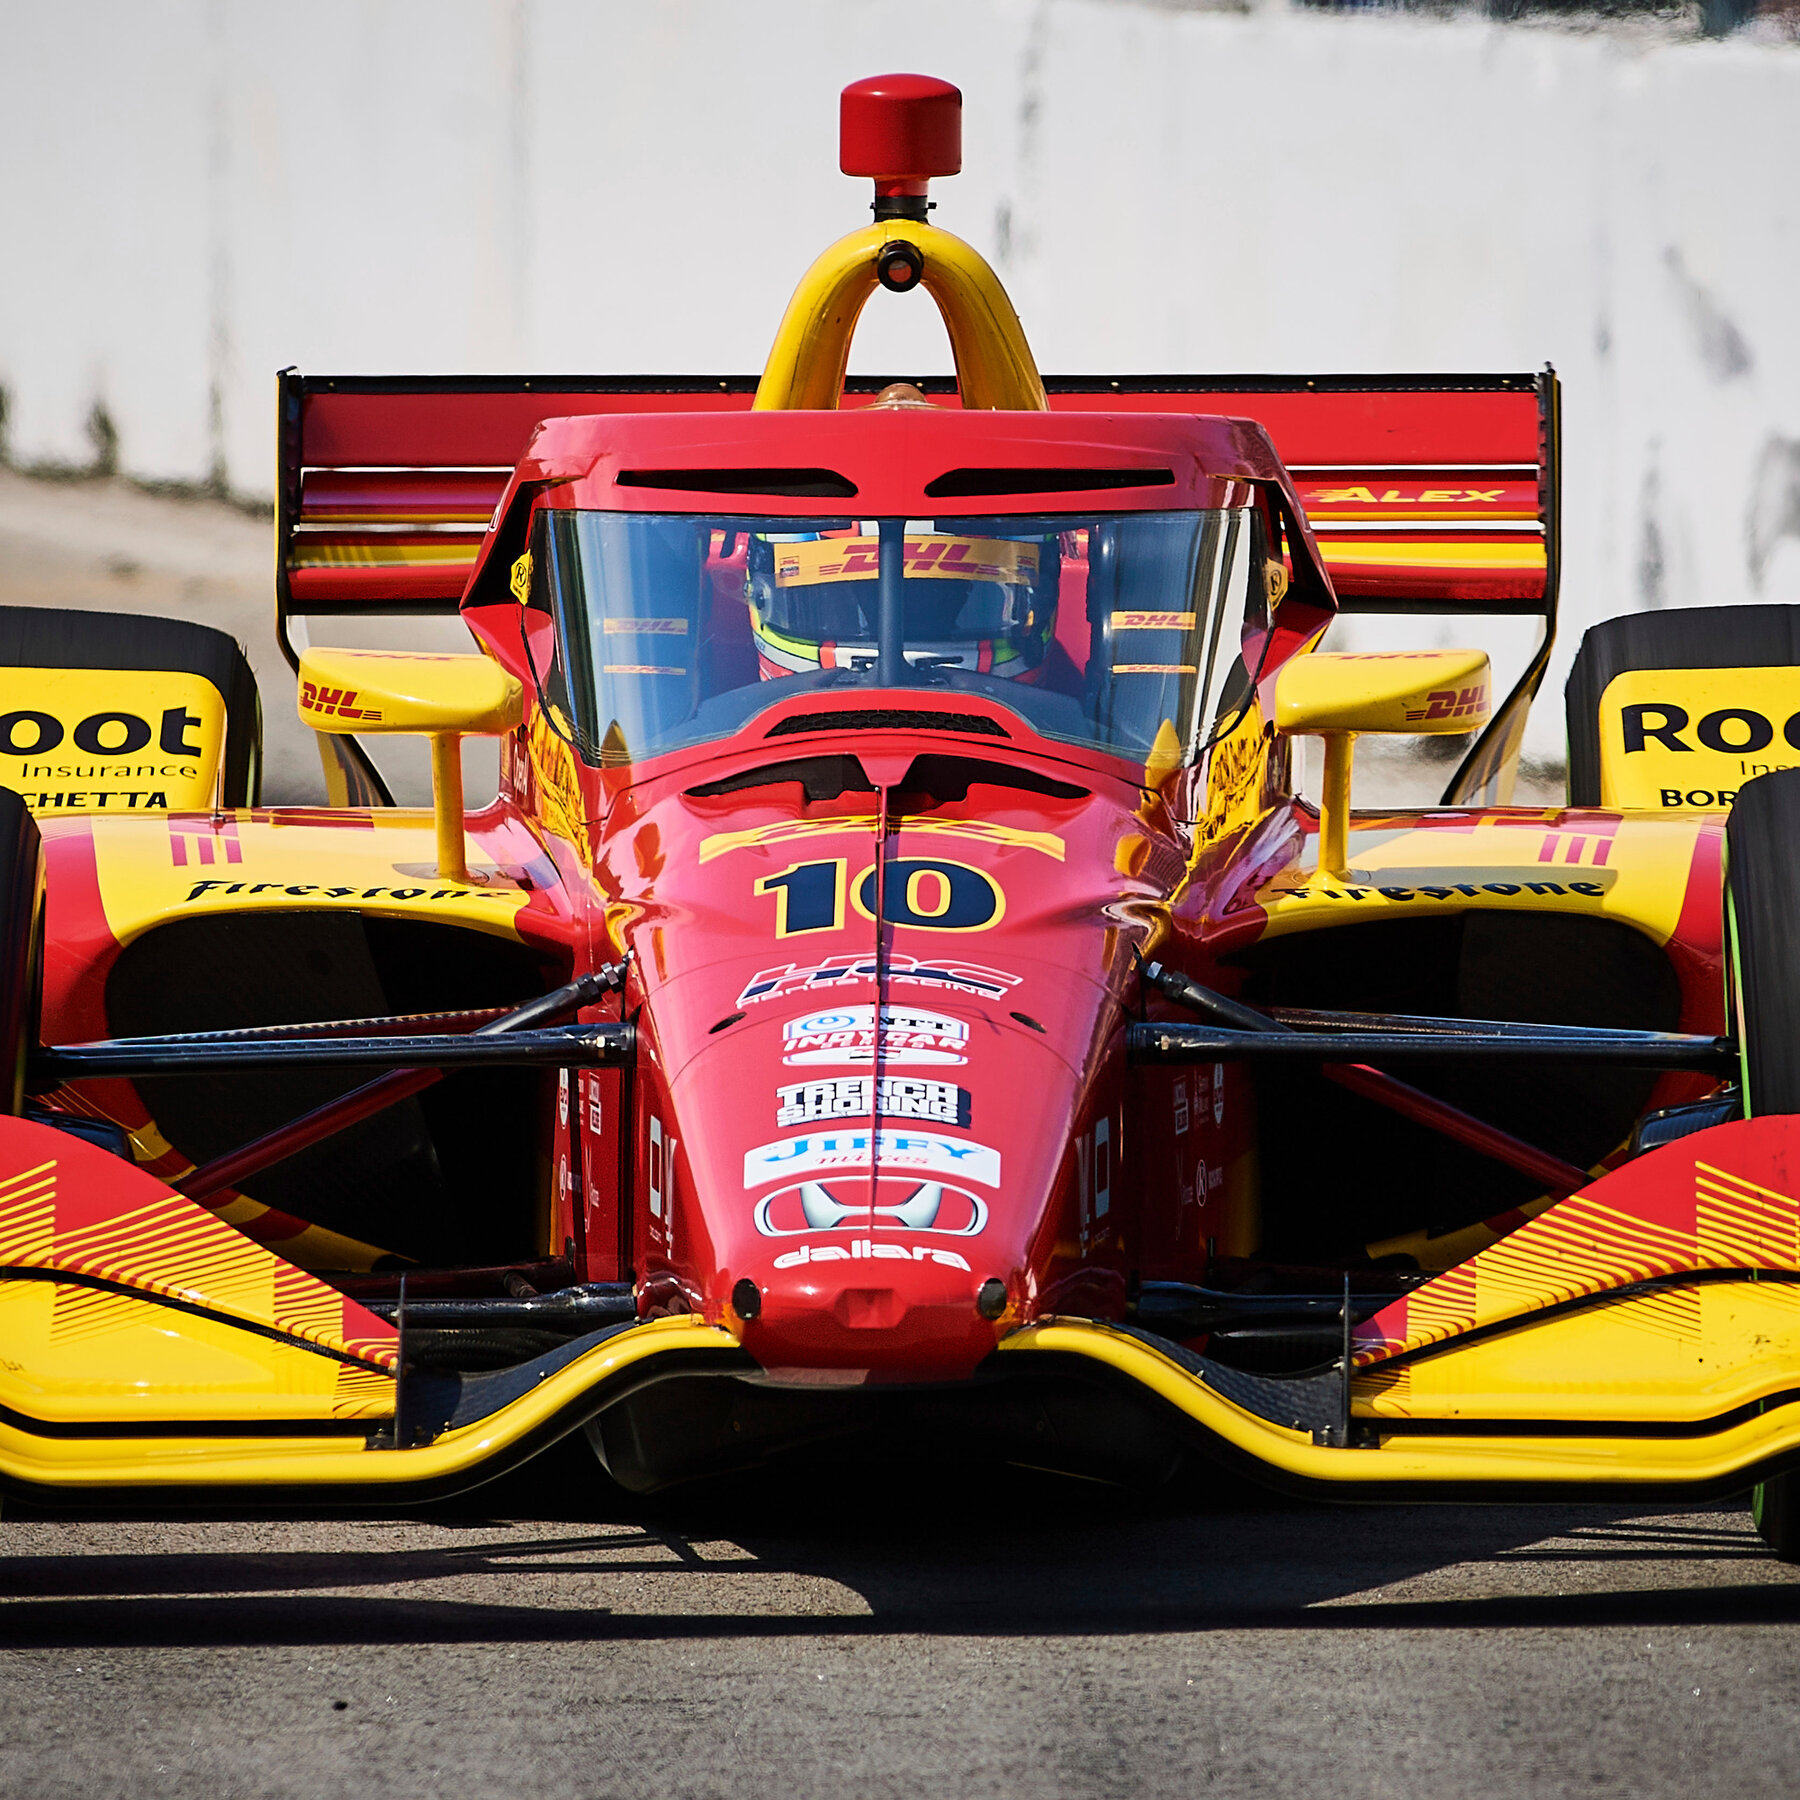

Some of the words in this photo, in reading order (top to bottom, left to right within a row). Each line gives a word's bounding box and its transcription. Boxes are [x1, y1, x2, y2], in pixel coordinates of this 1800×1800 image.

[1316, 486, 1505, 503] ALEX
[842, 542, 979, 573] DHL
[617, 620, 674, 630] DHL
[1125, 614, 1182, 626] DHL
[301, 681, 363, 719] DHL
[1621, 703, 1800, 754] Ro
[22, 763, 197, 779] Insurance
[185, 880, 517, 901] Firestone
[754, 857, 1006, 939] 10
[1271, 881, 1605, 902] Firestone
[737, 953, 1023, 1001] HRC
[869, 1015, 952, 1030] NTT
[784, 1030, 967, 1051] INDYCAR
[777, 1076, 958, 1106] TRENCH
[776, 1096, 958, 1121] SHORING
[763, 1136, 985, 1163] JIFFY
[815, 1151, 929, 1165] mixes
[773, 1240, 971, 1271] dallara
